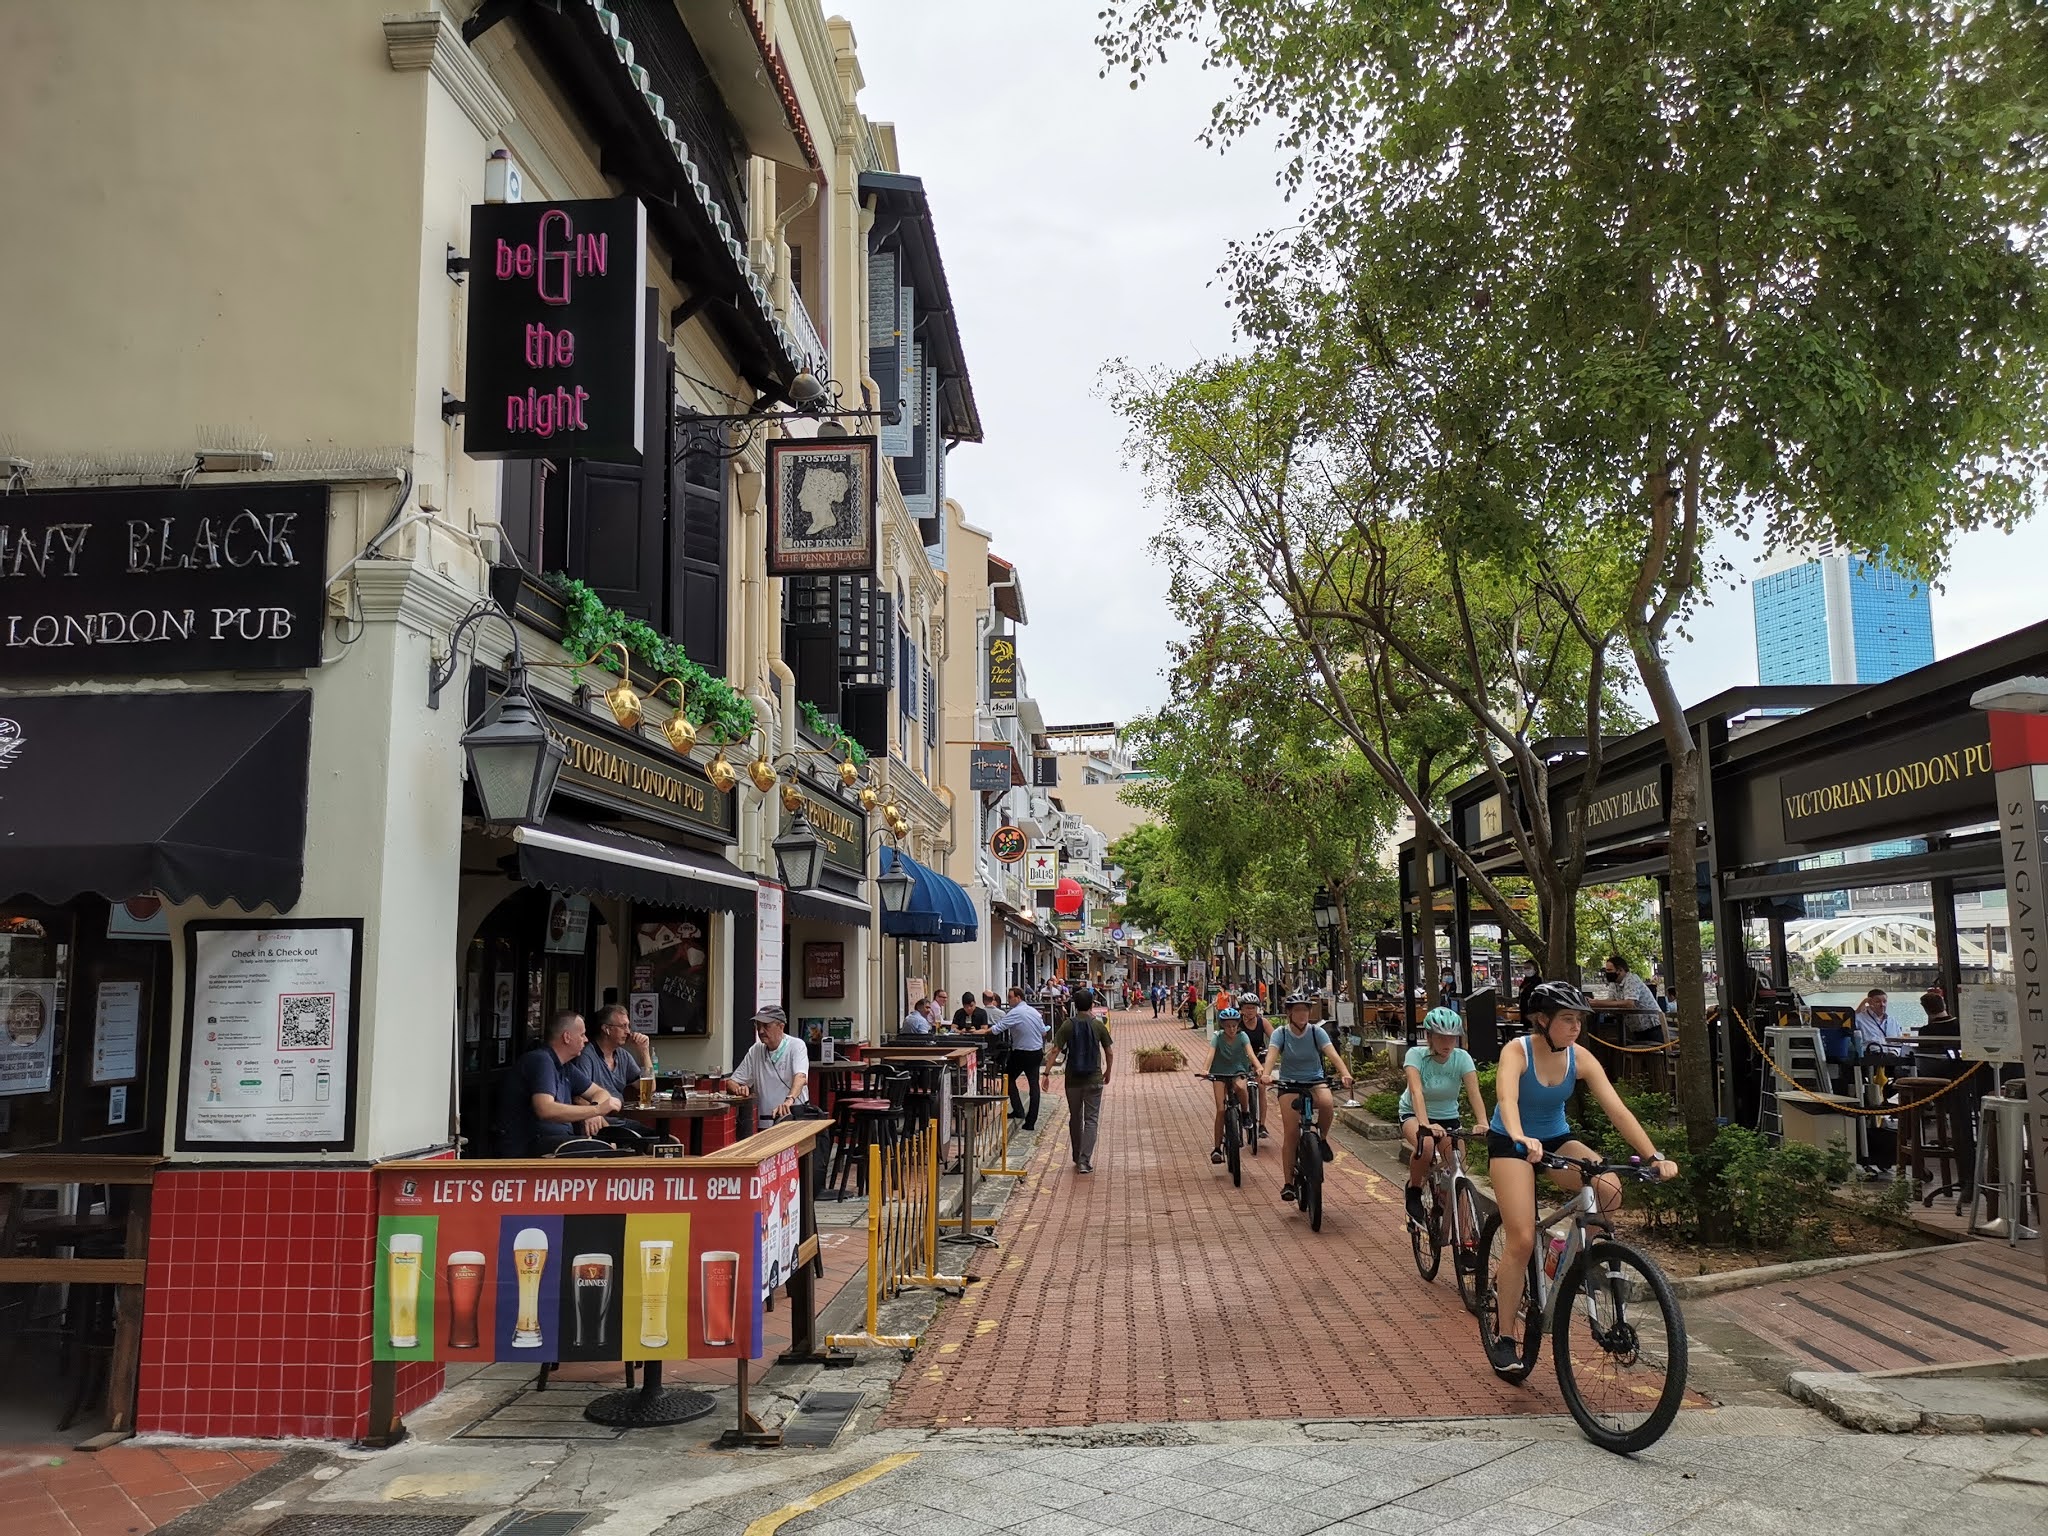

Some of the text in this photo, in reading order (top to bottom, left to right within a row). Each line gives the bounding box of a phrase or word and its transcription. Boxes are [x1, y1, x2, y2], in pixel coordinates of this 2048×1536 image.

[525, 321, 575, 368] the
[506, 384, 590, 438] night
[797, 454, 847, 463] POSTAGE
[125, 508, 300, 573] BLACK
[779, 551, 865, 562] THE PENNY BLACK
[793, 538, 852, 549] ONE PENNY
[6, 607, 297, 646] LONDON PUB
[991, 663, 1015, 674] Dark
[992, 702, 1015, 711] Asahi
[551, 730, 705, 812] CTORIAN LONDON PUB
[1785, 741, 1993, 820] VICTORIAN LONDON PU
[1587, 795, 1620, 827] PENNY
[1621, 781, 1660, 817] BLACK
[2008, 802, 2043, 1022] SINGAPORE
[231, 948, 318, 958] Check in & Check out
[433, 1179, 484, 1203] LET'S
[491, 1179, 527, 1203] GET
[534, 1178, 598, 1202] HAPPY
[606, 1178, 655, 1201] HOUR
[664, 1177, 698, 1201] TILL
[706, 1177, 741, 1200] 8PM
[577, 1279, 608, 1287] GUINNESS
